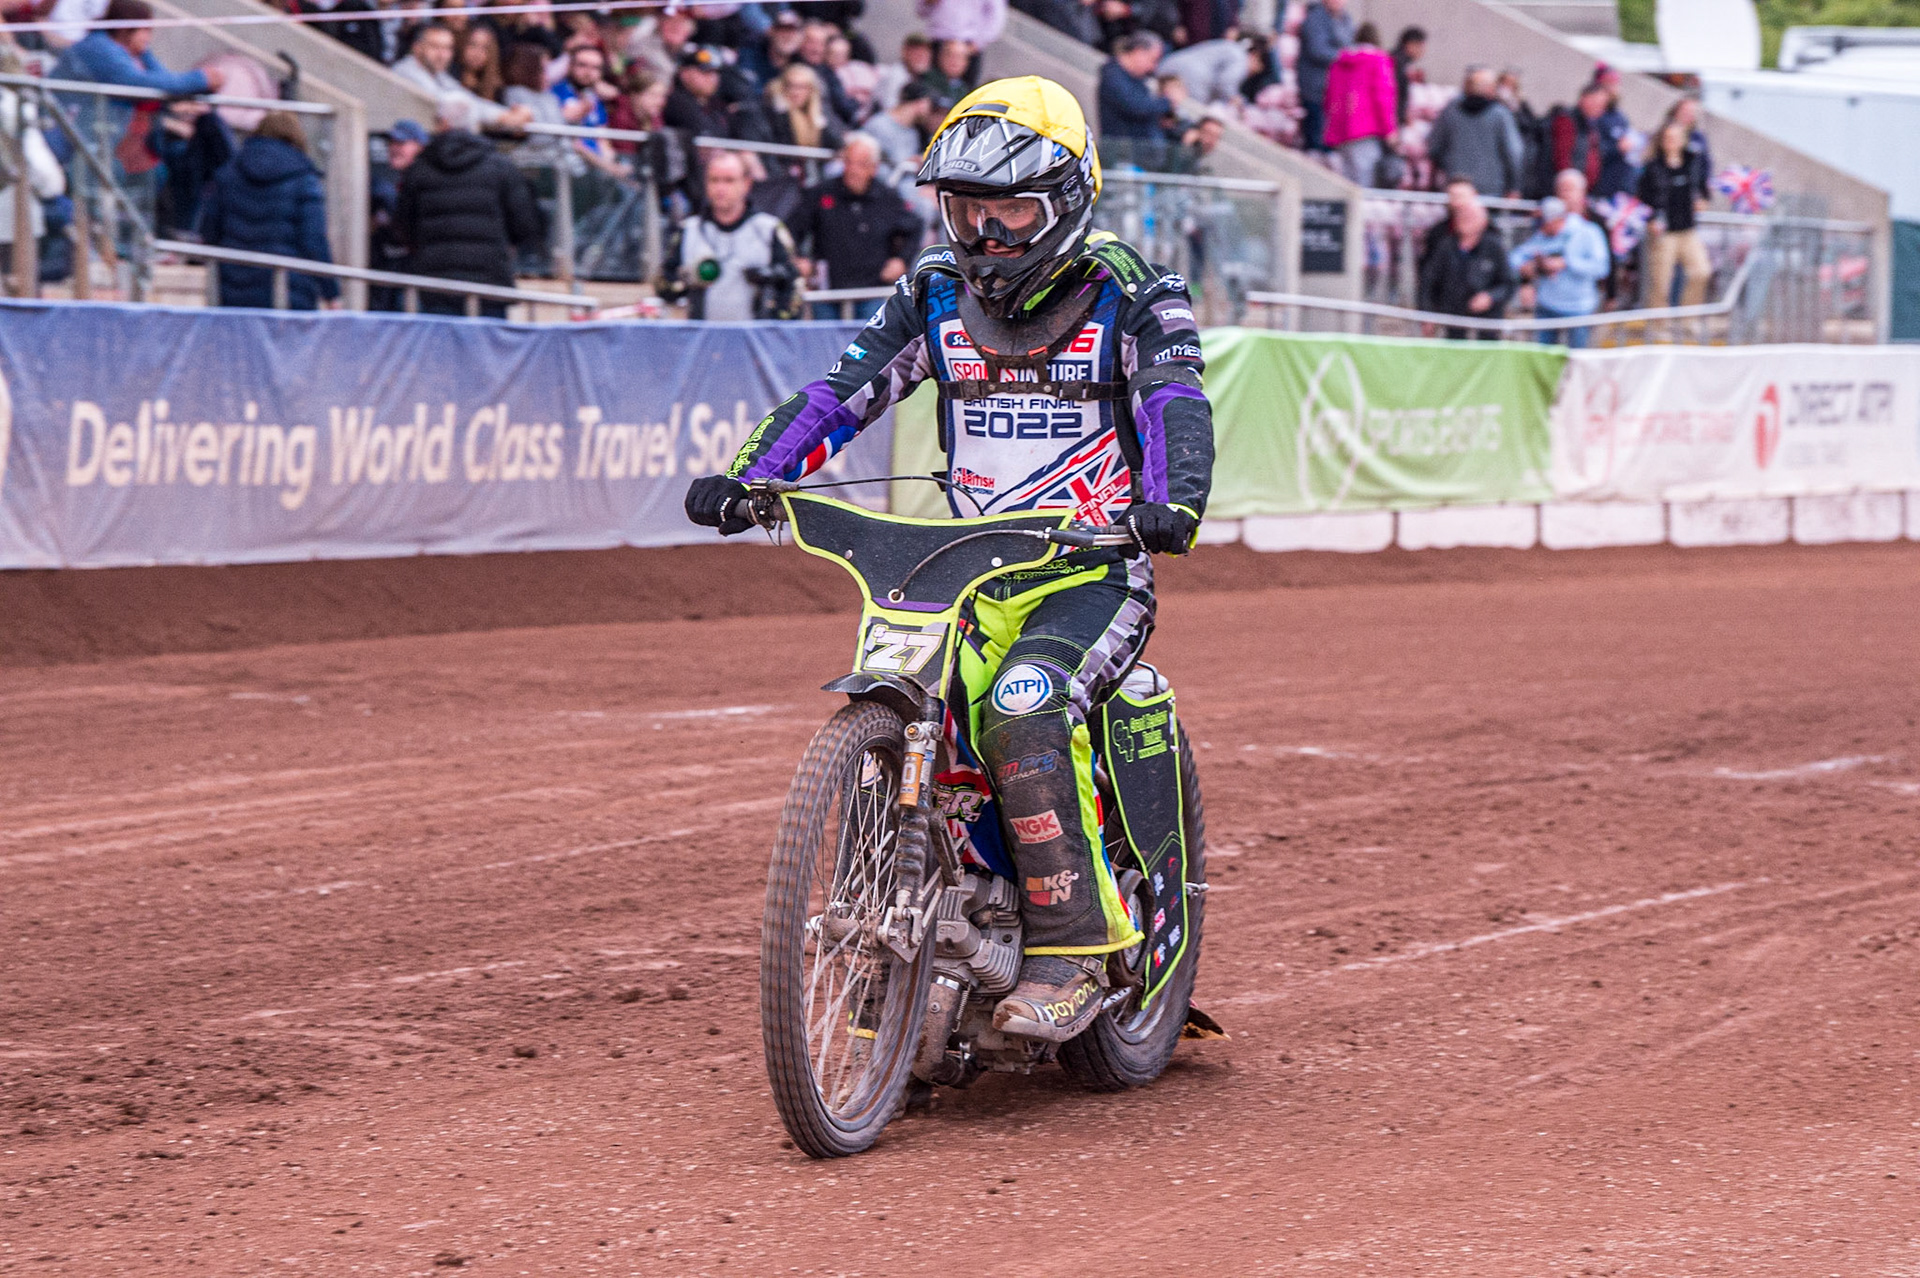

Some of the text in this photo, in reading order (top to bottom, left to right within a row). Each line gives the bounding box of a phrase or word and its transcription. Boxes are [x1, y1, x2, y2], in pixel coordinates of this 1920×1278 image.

[943, 159, 977, 173] SHOEI
[963, 397, 1083, 410] BRITISH FINAL
[963, 409, 1083, 439] 2022
[66, 398, 318, 511] Delivering
[328, 402, 457, 486] World
[463, 403, 565, 483] Class
[574, 403, 682, 479] Travel
[961, 474, 995, 489] BRITISH
[1079, 481, 1125, 518] FINAL
[863, 630, 944, 675] 27
[999, 678, 1042, 699] ATPI
[1013, 813, 1058, 836] NGK
